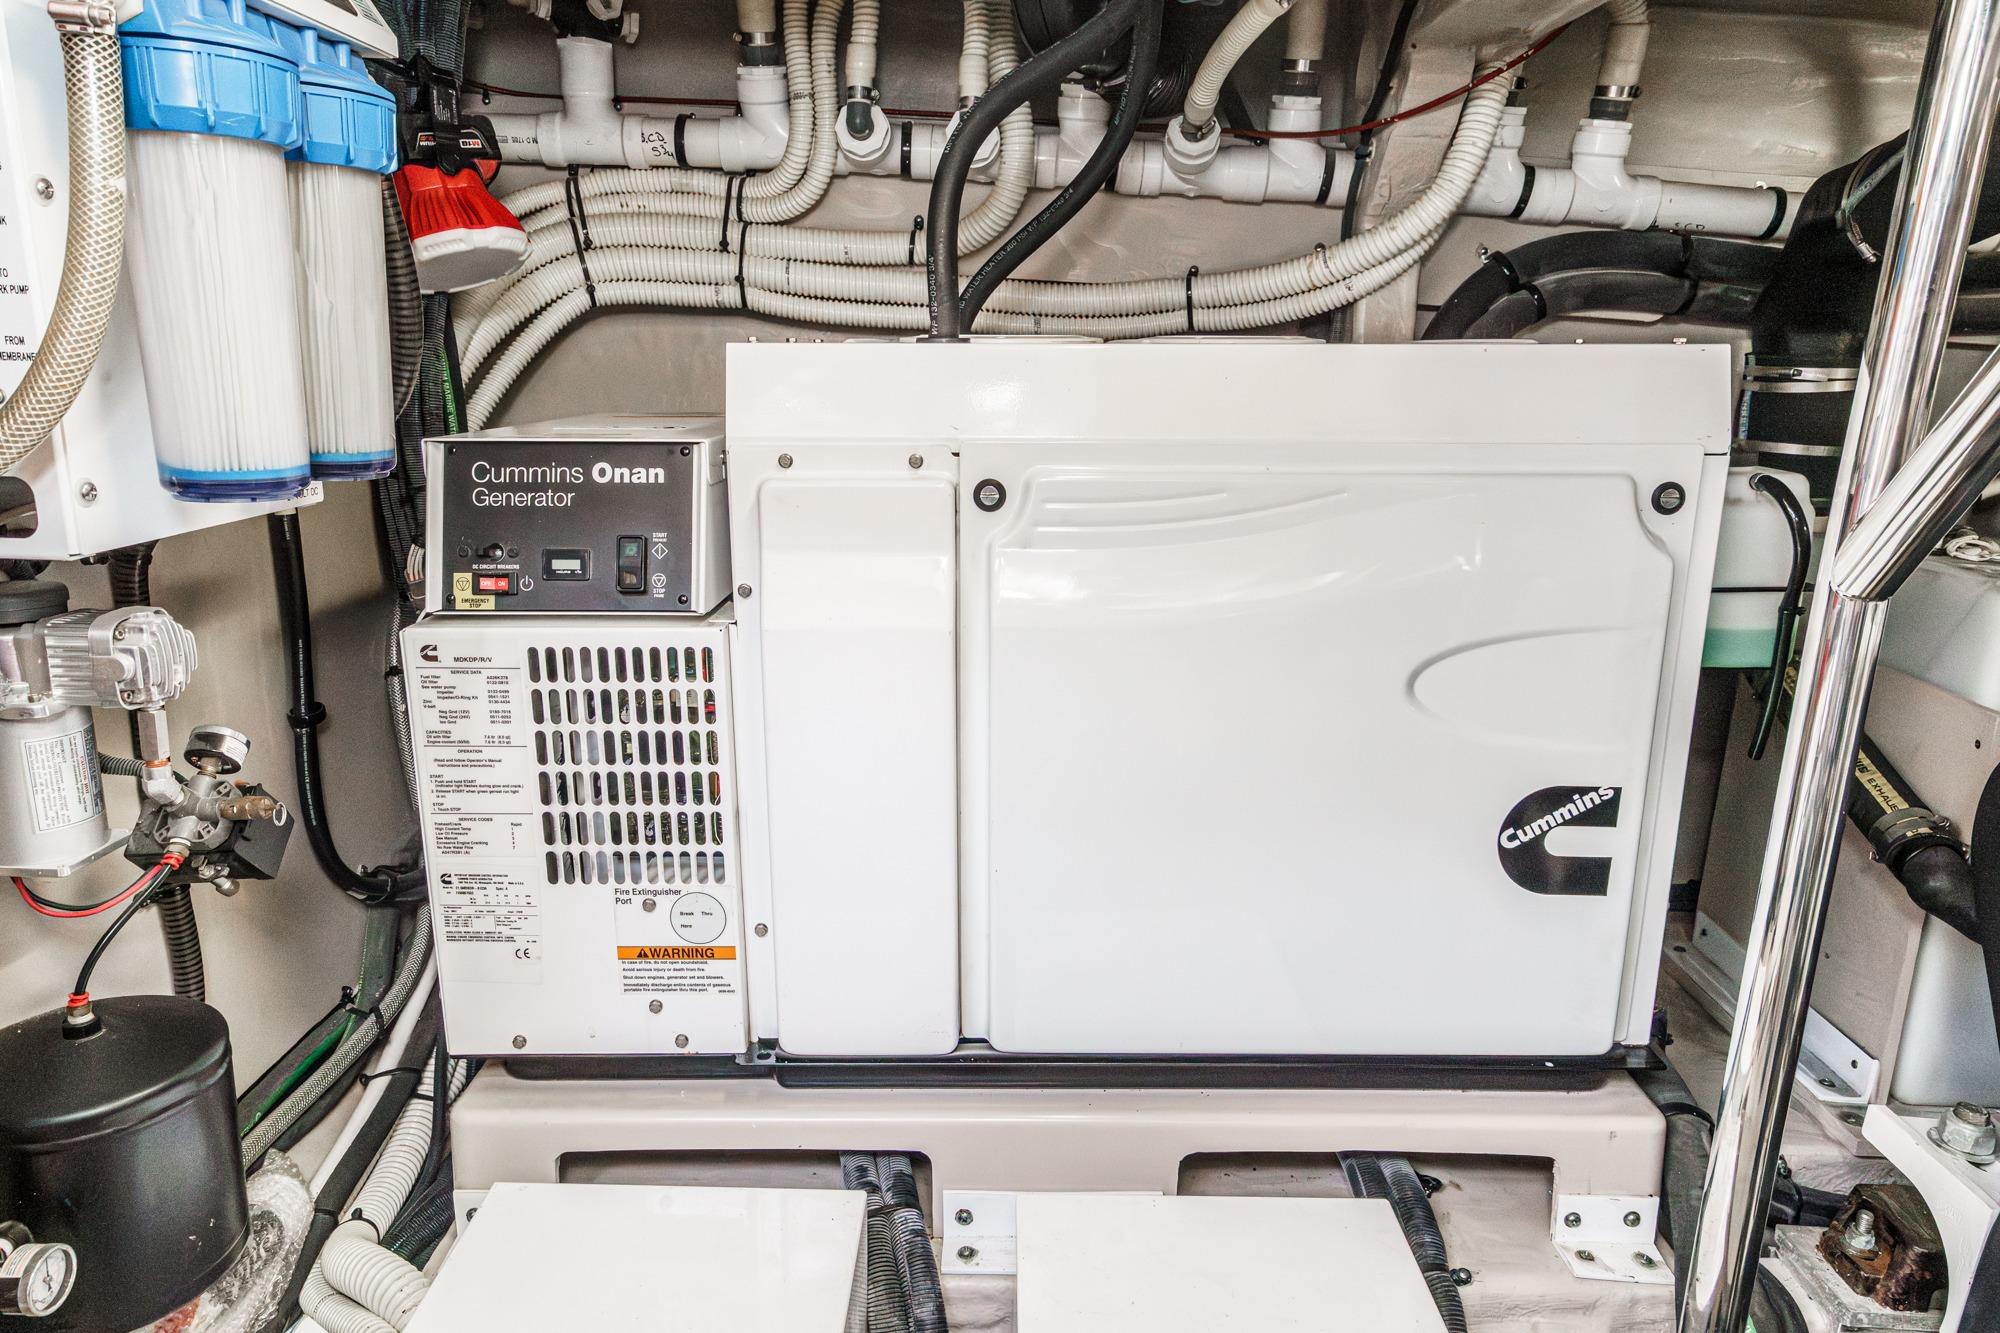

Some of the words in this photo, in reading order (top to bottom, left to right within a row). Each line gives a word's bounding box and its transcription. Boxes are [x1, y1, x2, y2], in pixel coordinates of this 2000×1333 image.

[981, 250, 1007, 276] HEATER
[10, 284, 29, 295] PUMP
[5, 335, 25, 346] FROM
[471, 461, 584, 484] Cummins
[592, 462, 665, 484] Onan
[472, 487, 576, 507] Generator
[1867, 777, 1900, 812] EXHAUS
[1500, 786, 1615, 849] Cummins
[614, 888, 630, 896] Fire
[632, 888, 682, 897] Extinguisher
[615, 897, 632, 905] Port
[649, 947, 715, 959] WARNING
